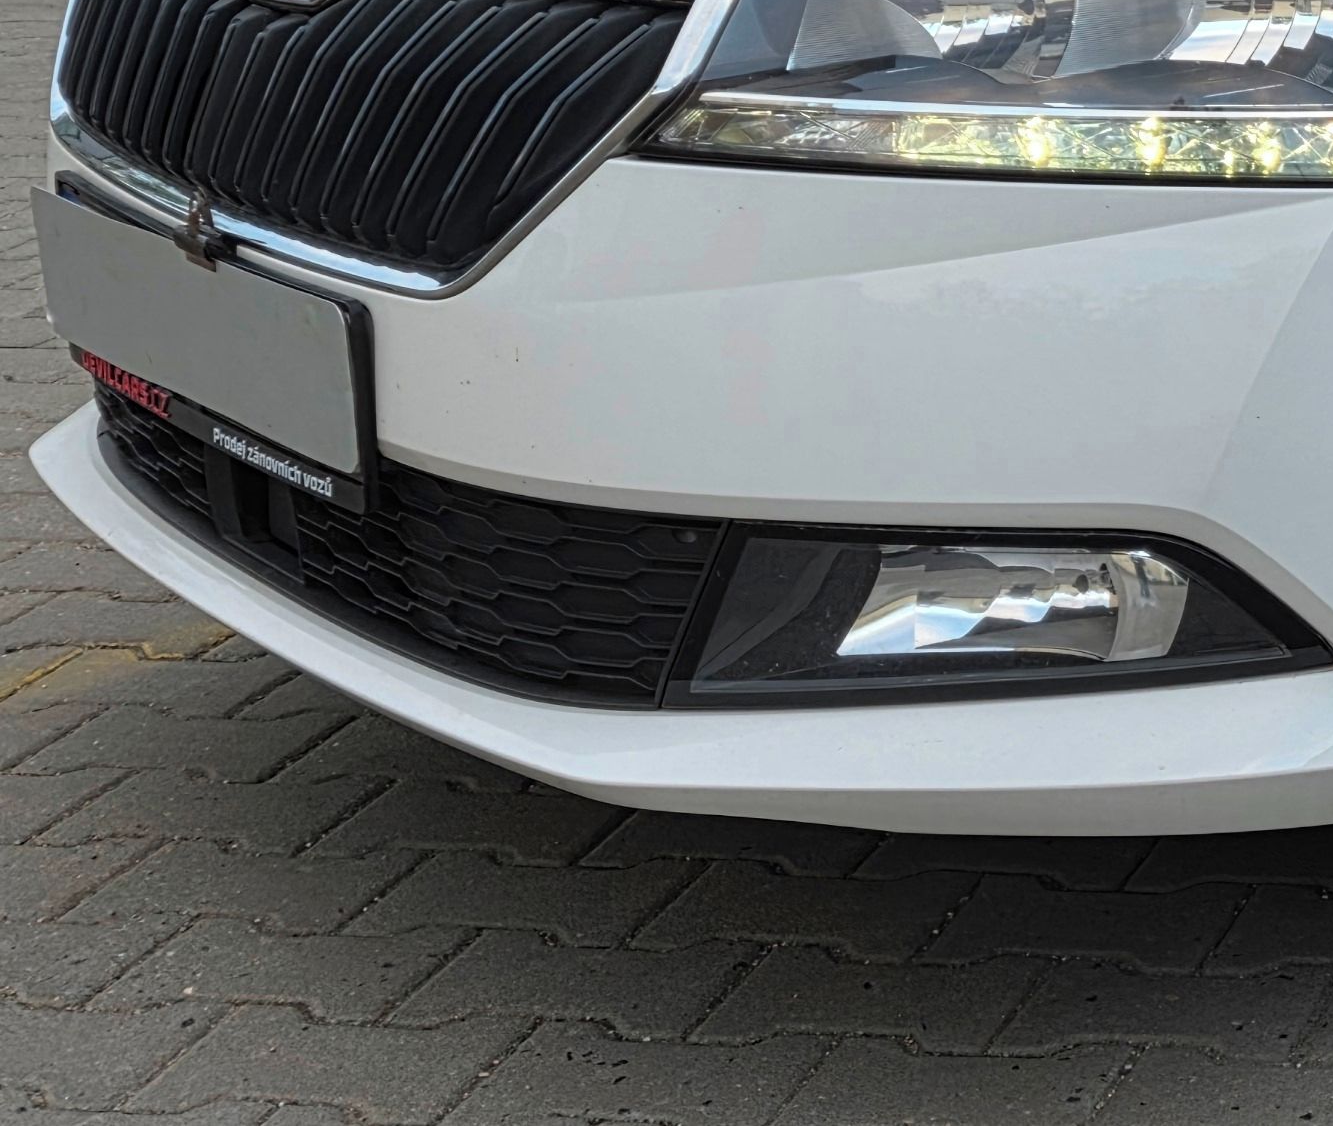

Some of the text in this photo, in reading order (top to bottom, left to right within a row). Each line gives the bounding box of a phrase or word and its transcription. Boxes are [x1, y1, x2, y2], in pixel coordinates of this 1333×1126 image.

[213, 427, 333, 498] Prodej zánovních vozů
